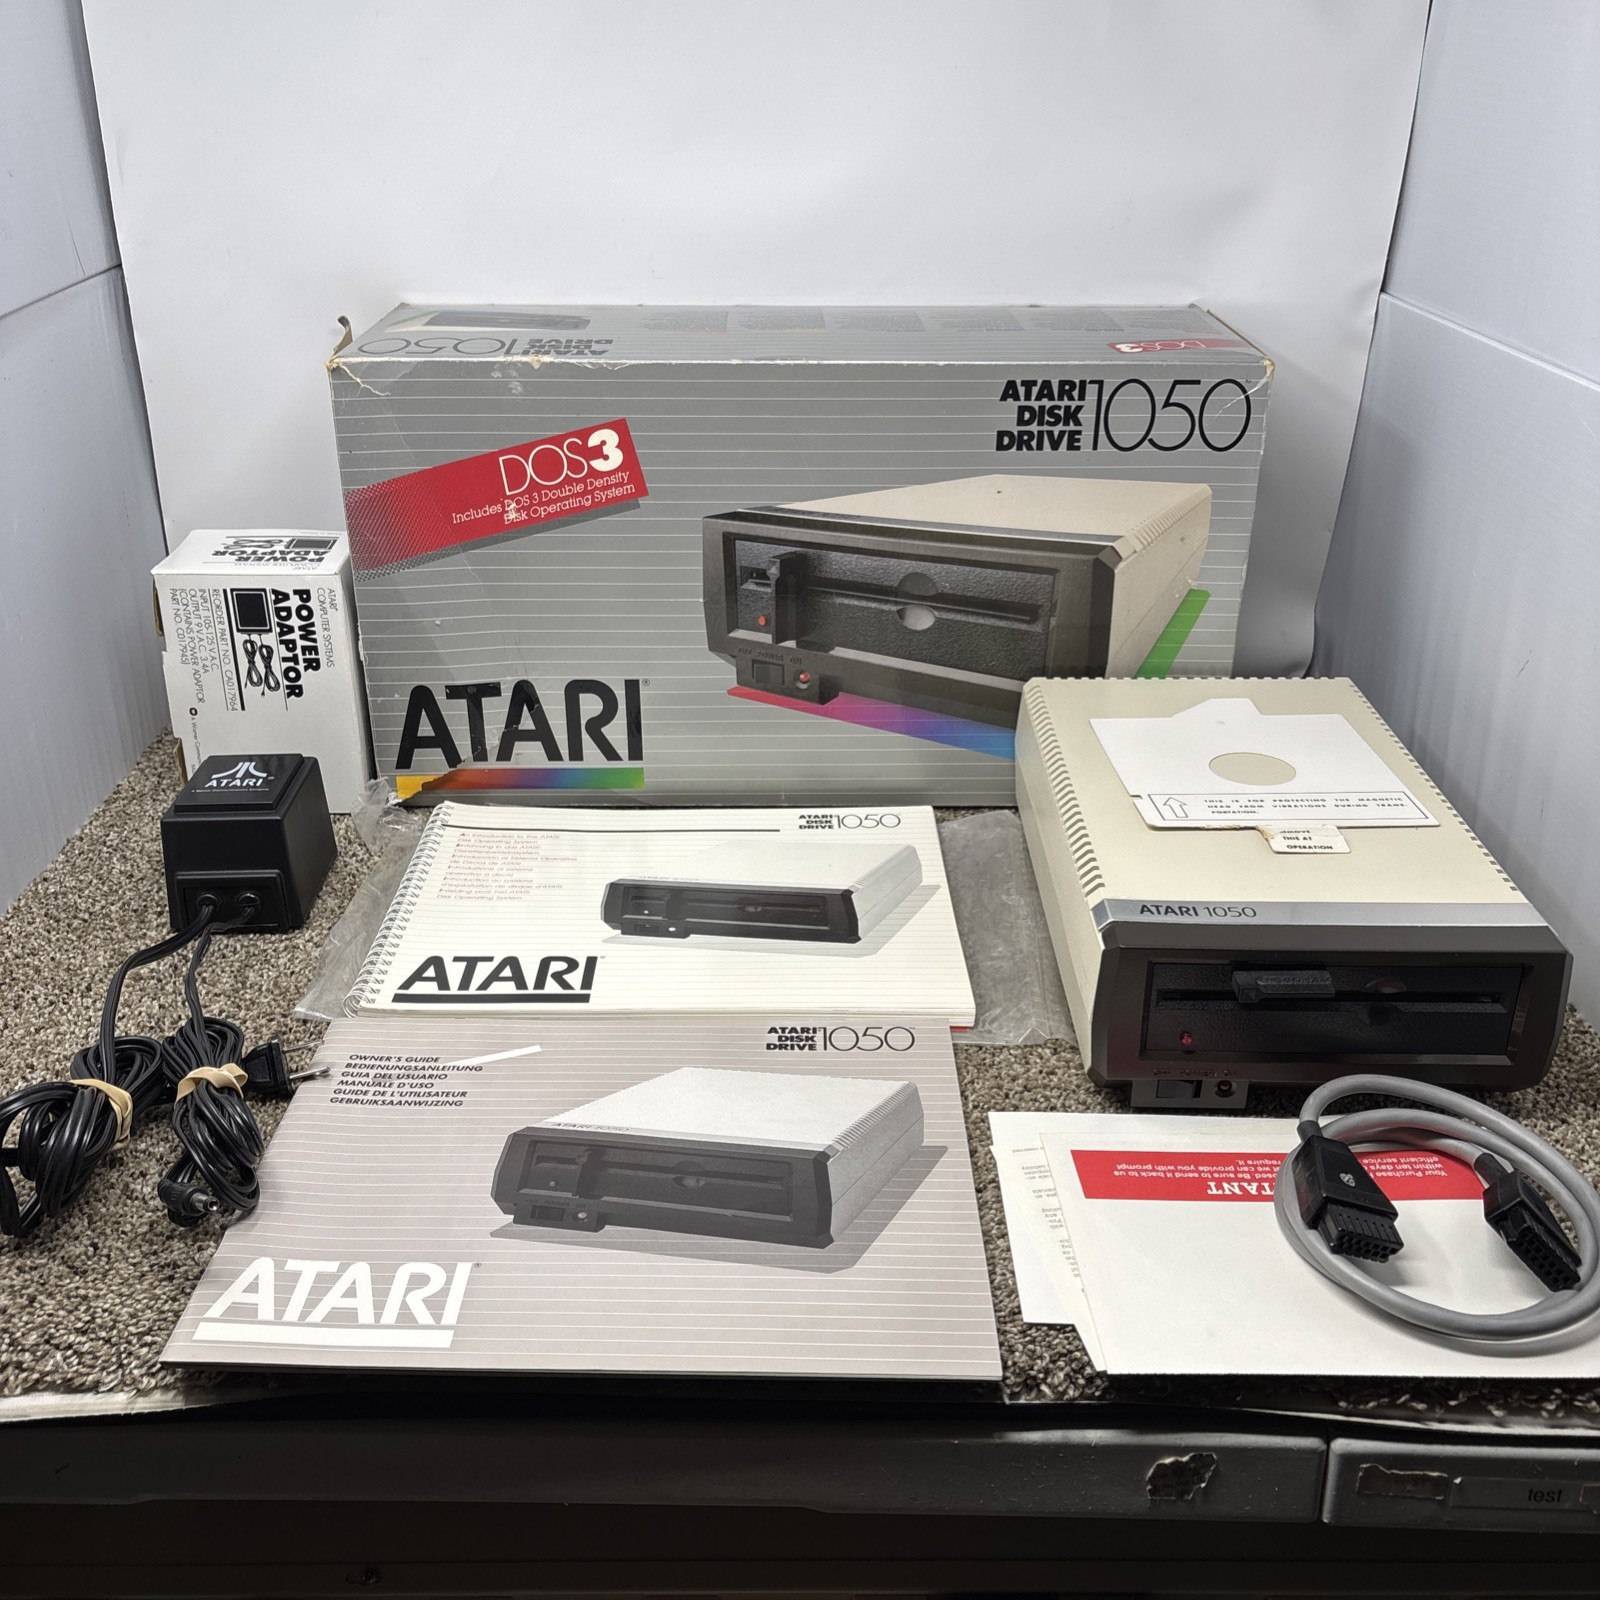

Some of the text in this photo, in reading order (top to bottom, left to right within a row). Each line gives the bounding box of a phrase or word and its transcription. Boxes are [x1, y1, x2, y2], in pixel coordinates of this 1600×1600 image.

[1000, 380, 1087, 402] ATARI
[1017, 406, 1083, 427] DISK
[1087, 378, 1252, 452] 1050
[995, 430, 1082, 452] DRIVE
[452, 471, 630, 524] Includes DOS 3 Double Density
[504, 484, 636, 524] Disk Operating System
[198, 588, 210, 612] INPUT
[327, 588, 339, 610] ATARI
[169, 588, 191, 665] PART NO. C017945)
[188, 588, 202, 620] OUTPUT
[199, 656, 210, 674] 3.4A
[202, 615, 215, 646] 105-125
[292, 588, 321, 672] POWER
[317, 588, 335, 668] COMPUTER SYSTEMS
[178, 588, 205, 704] (CONTAINS POWER ADAPTOR
[211, 589, 238, 712] REORDER PART NO. CA017964
[271, 588, 304, 699] ADAPTOR
[395, 679, 644, 770] ATARI
[204, 778, 264, 788] ATARI
[834, 813, 901, 829] 1050
[1139, 904, 1257, 918] ATARI 1050
[397, 955, 598, 991] ATARI
[767, 1026, 818, 1034] ATARI
[777, 1034, 817, 1042] DISK
[818, 1026, 916, 1051] 1050
[344, 1063, 483, 1072] BEDIENUNGSANLEITUNG
[349, 1054, 441, 1064] OWNER'S GUIDE
[337, 1080, 394, 1088] MANUALE
[341, 1071, 370, 1079] GUIA
[329, 1097, 464, 1107] GEBRUIKSAANWIJZING
[333, 1088, 369, 1096] GUIDE
[390, 1090, 468, 1098] L'UTILISATEUR
[1197, 1164, 1235, 1172] provide
[1369, 1163, 1392, 1171] days
[1399, 1156, 1439, 1164] efficient
[1237, 1172, 1251, 1180] Be
[1375, 1170, 1422, 1178] Purchase
[1424, 1170, 1448, 1178] Your
[202, 1256, 473, 1325] ATARI
[1528, 1488, 1563, 1503] test
